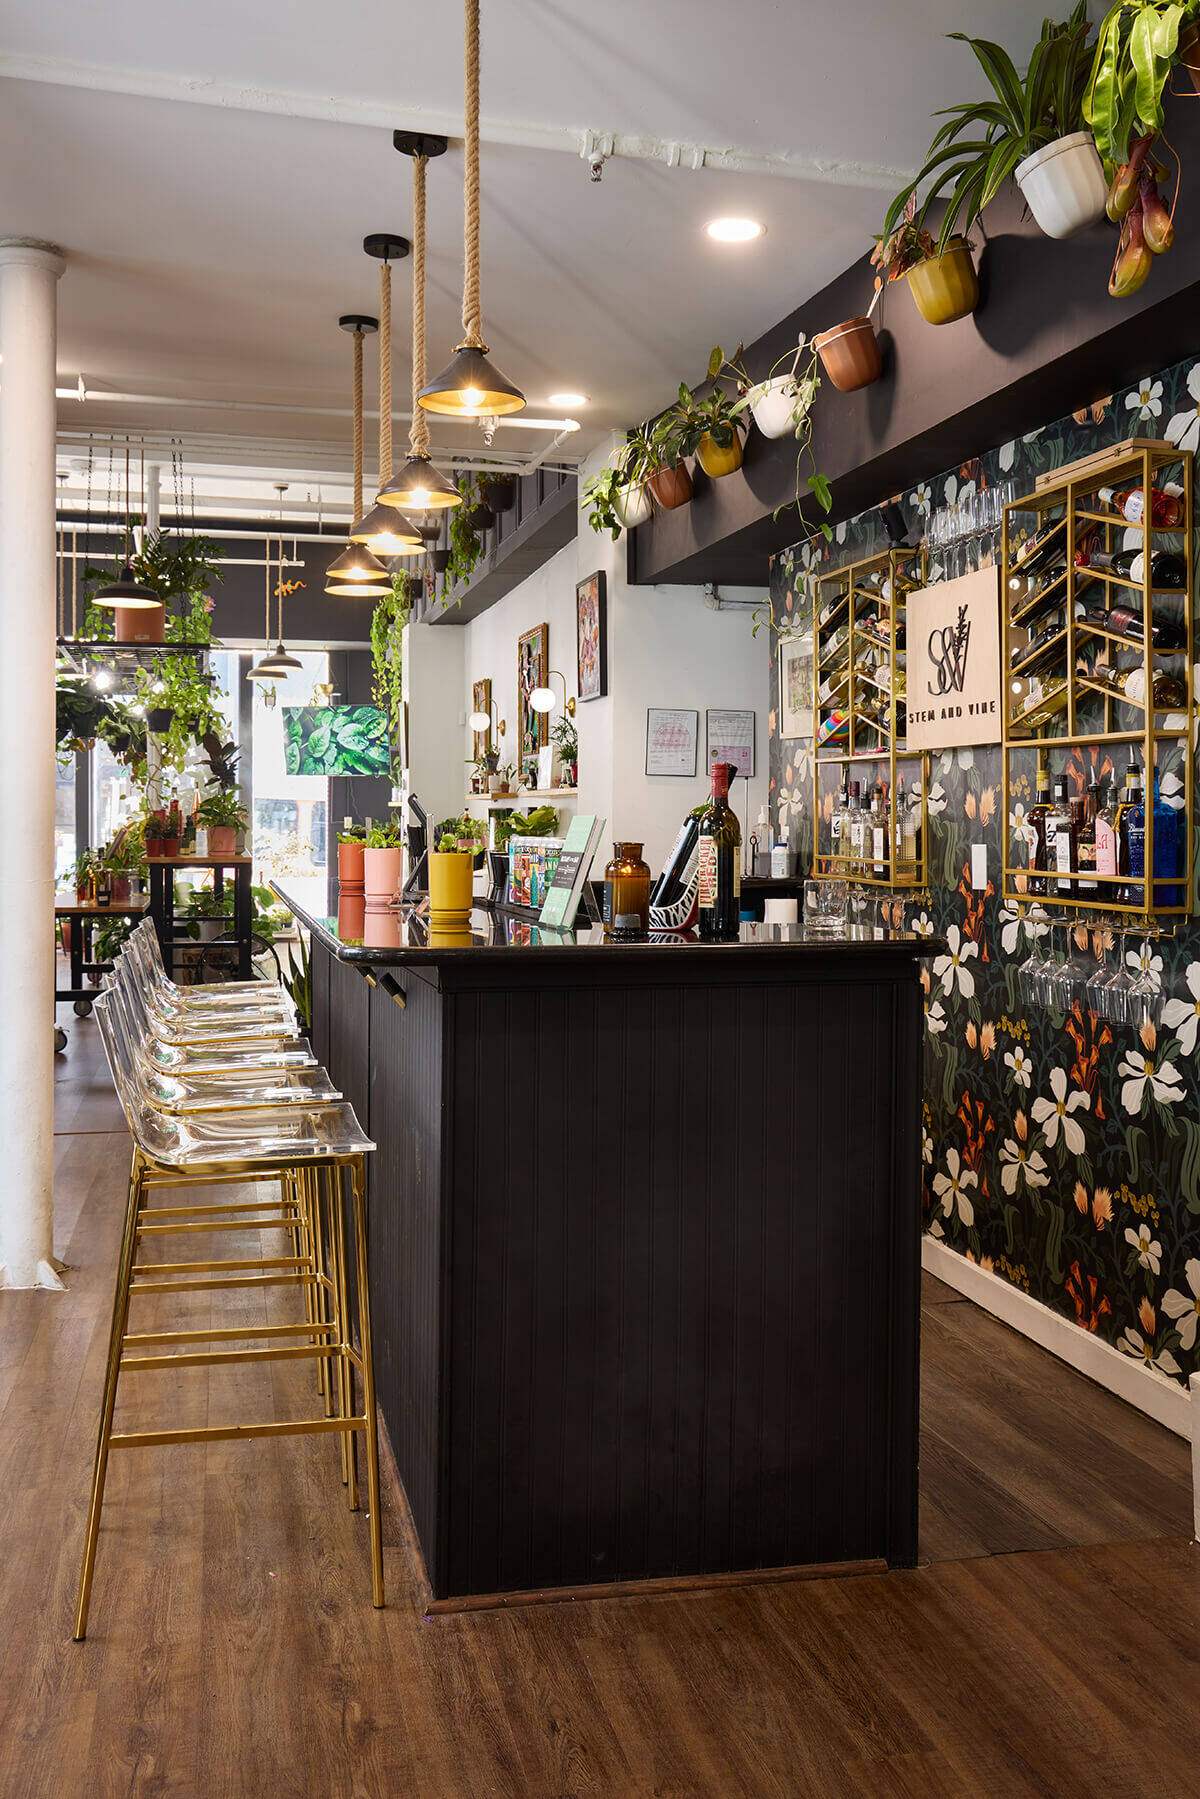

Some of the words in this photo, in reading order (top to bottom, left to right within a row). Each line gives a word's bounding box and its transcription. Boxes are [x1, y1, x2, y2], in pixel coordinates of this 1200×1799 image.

[909, 710, 935, 724] STEM
[941, 706, 962, 719] AND
[968, 700, 996, 715] VINE
[699, 838, 713, 905] FIRECRACKER
[705, 856, 717, 889] RED
